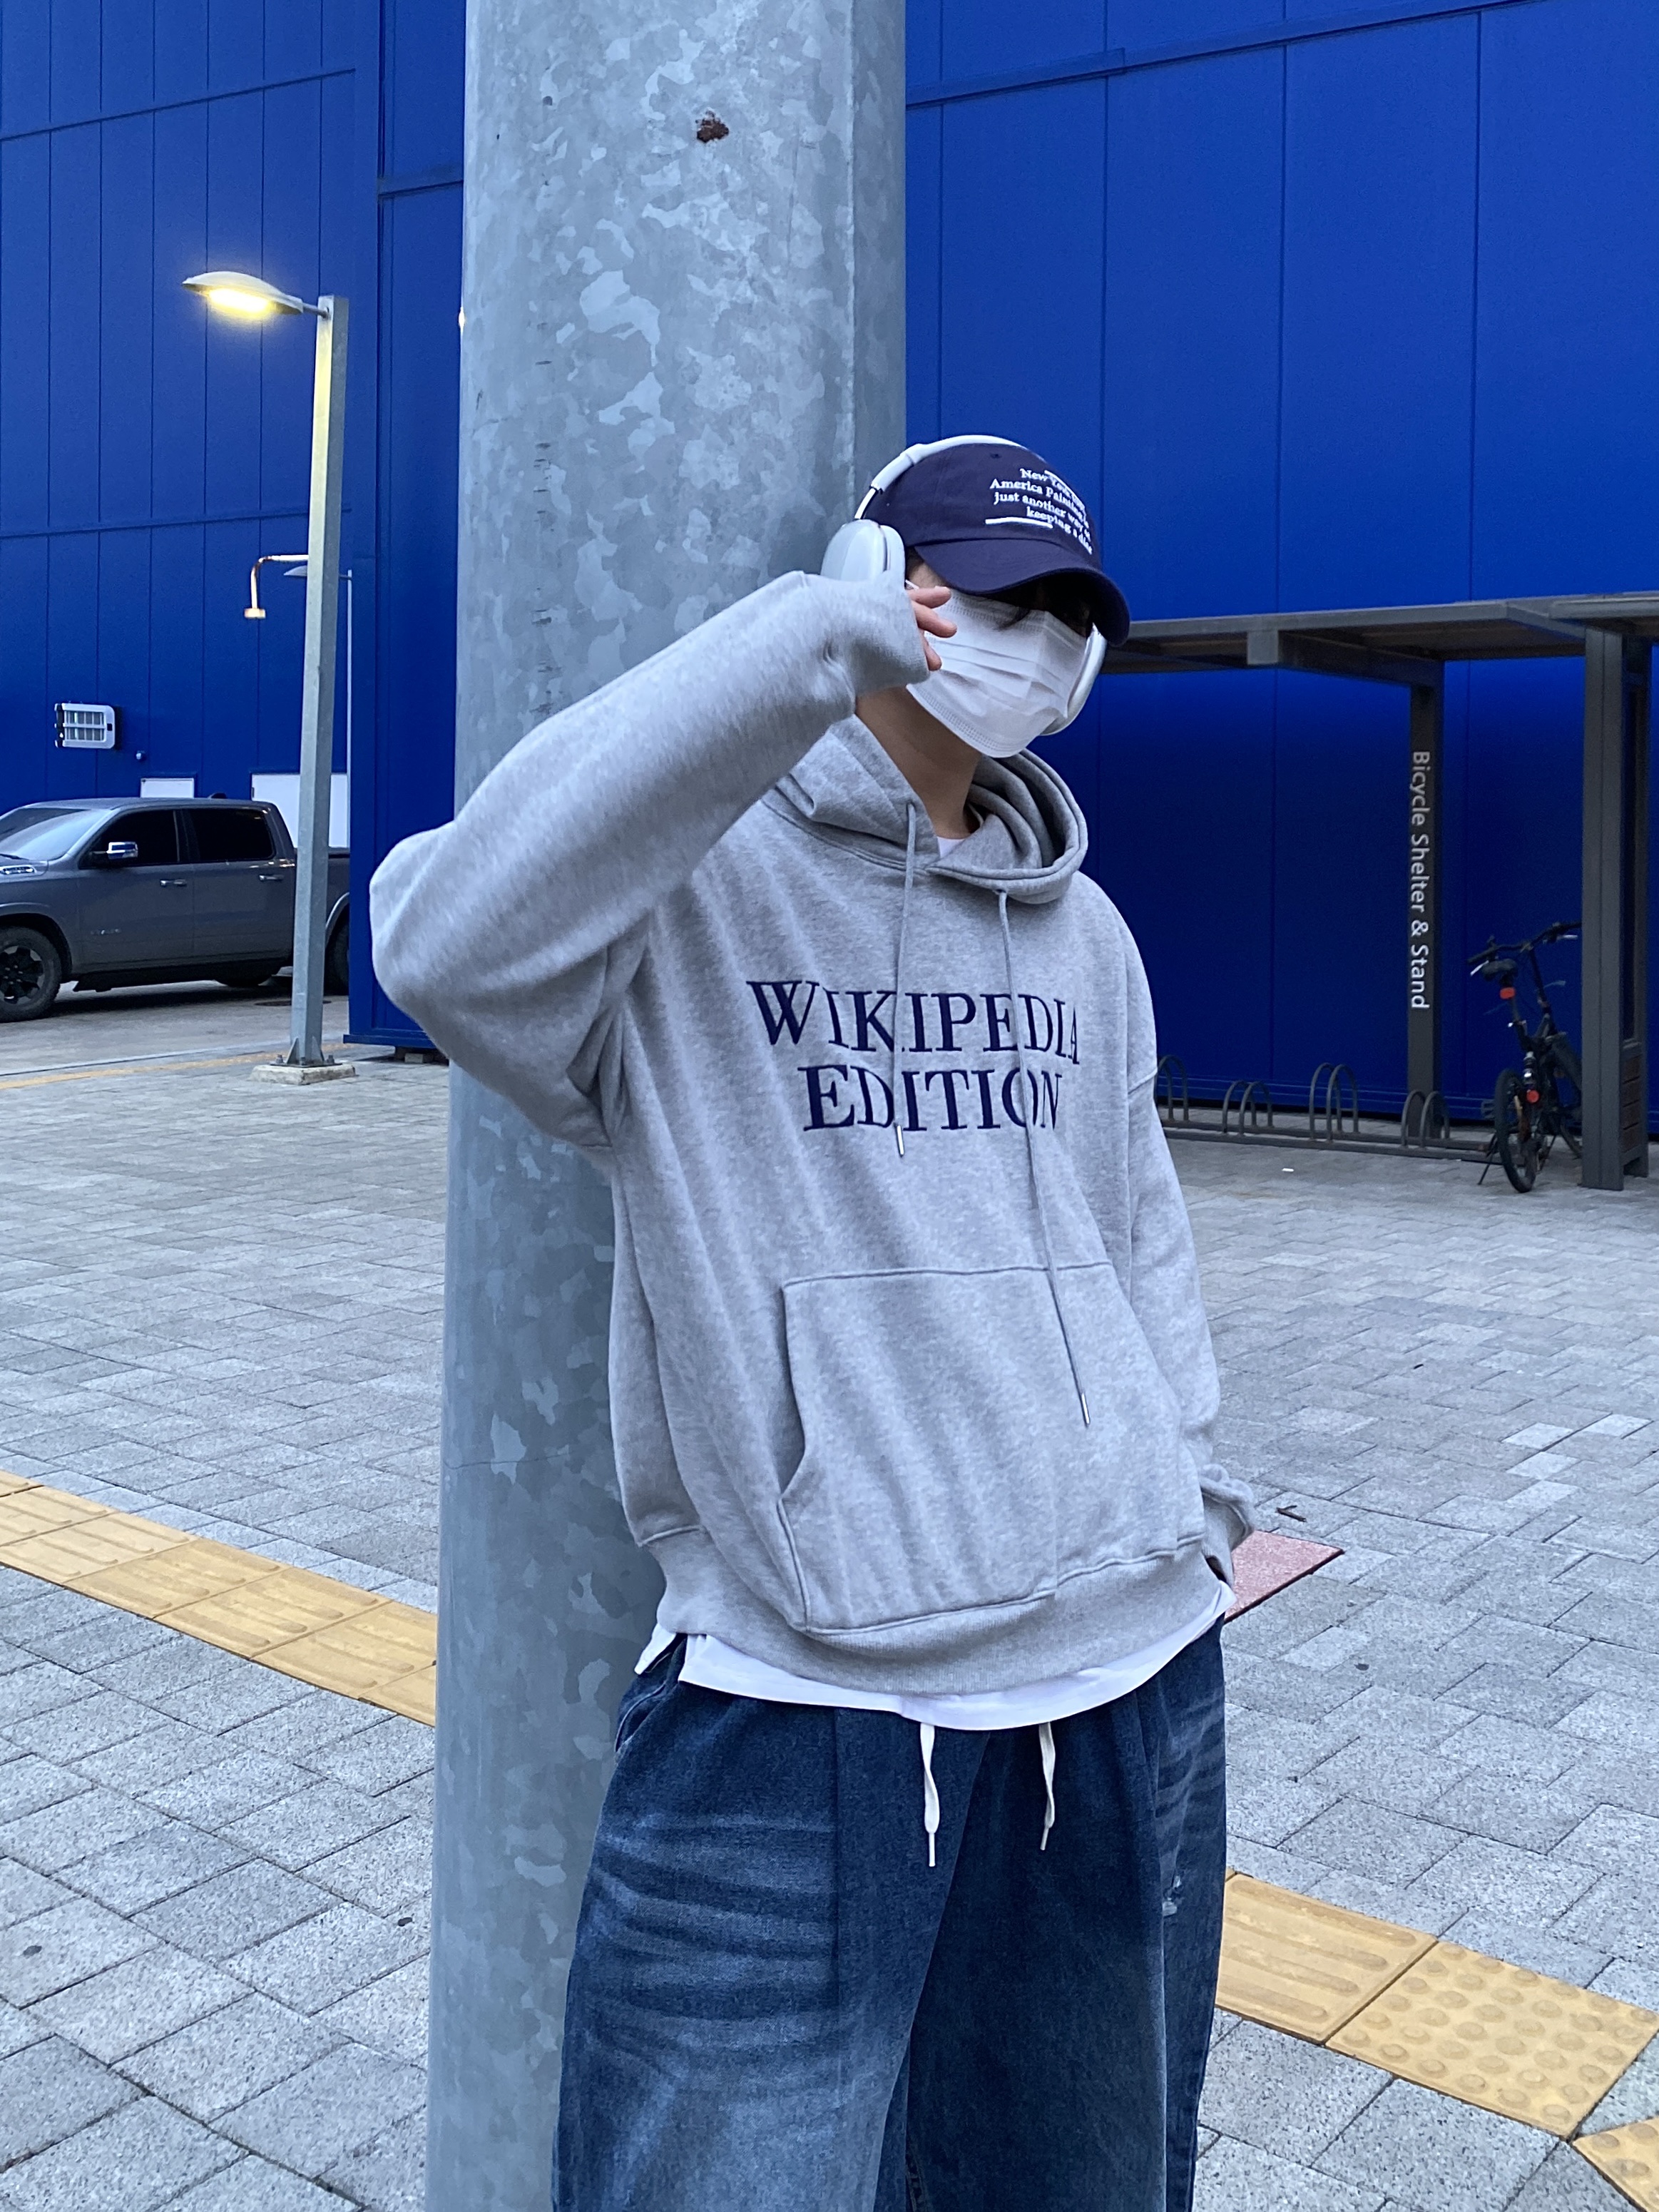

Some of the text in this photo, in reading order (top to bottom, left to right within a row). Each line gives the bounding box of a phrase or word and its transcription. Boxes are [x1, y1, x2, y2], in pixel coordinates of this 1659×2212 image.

[989, 478, 1043, 494] America
[1019, 468, 1048, 482] New
[993, 491, 1020, 505] just
[1022, 495, 1067, 519] another
[1026, 506, 1072, 534] keeping
[1409, 750, 1431, 1009] Bicycle Shelter & Stand
[745, 979, 1081, 1131] WIKIPEDIA EDITION
